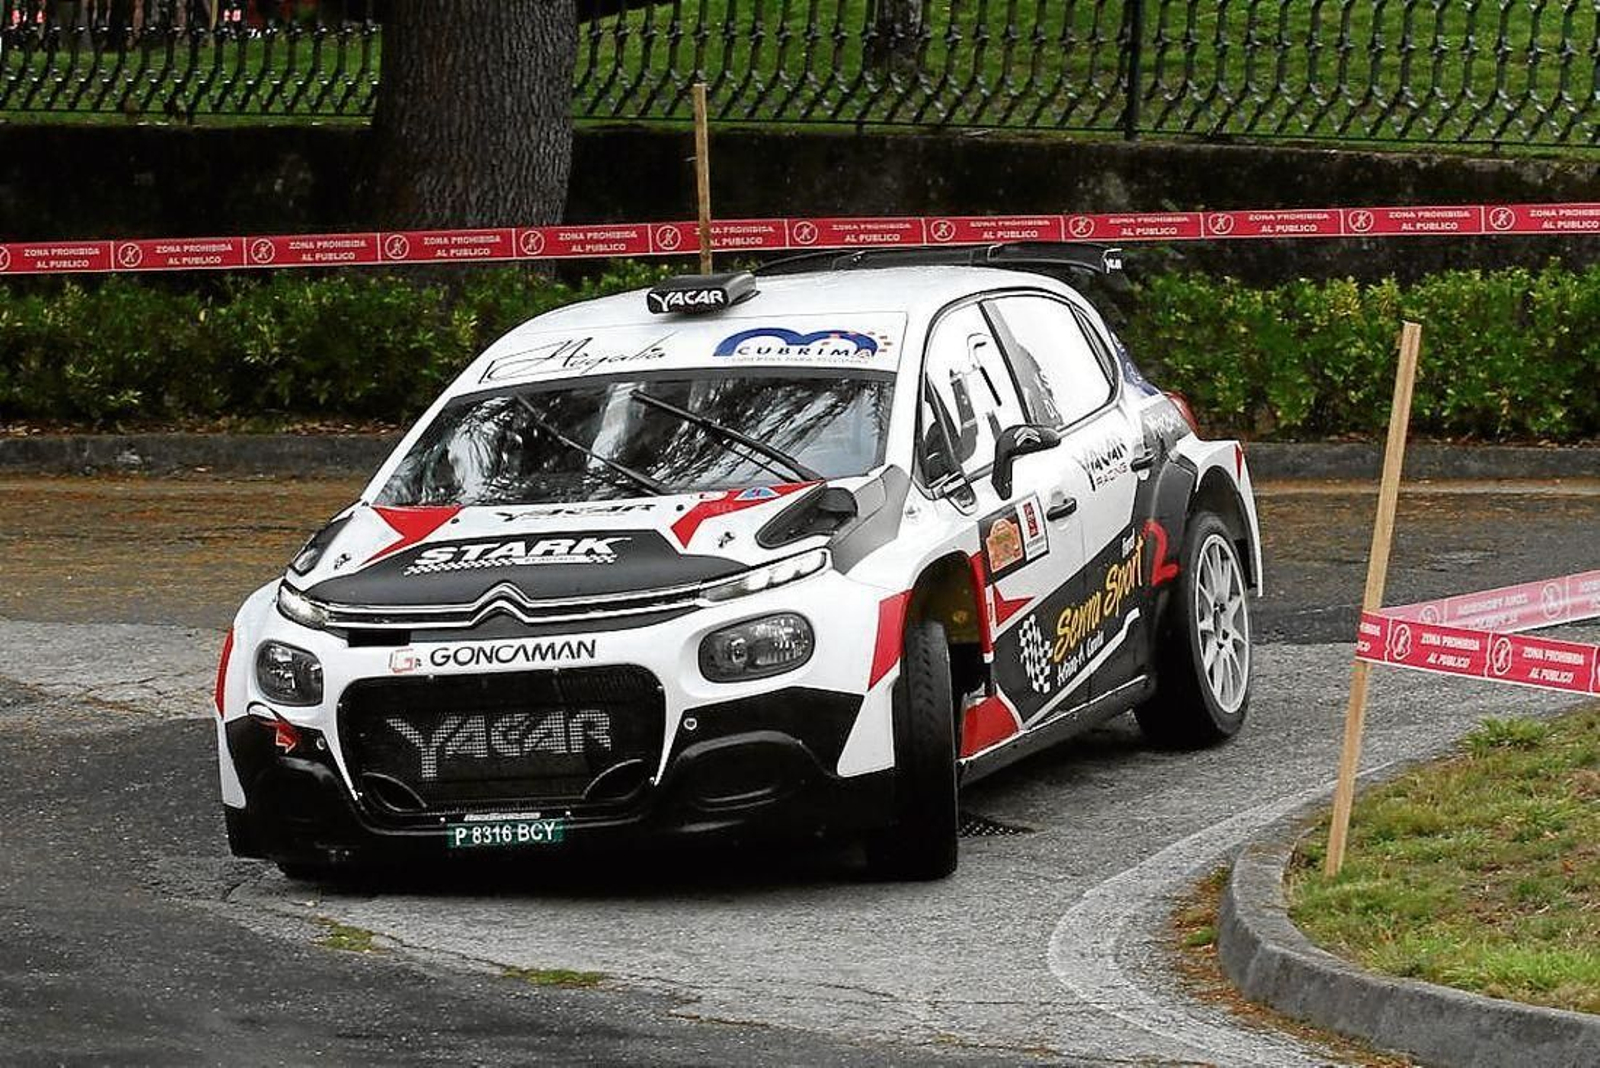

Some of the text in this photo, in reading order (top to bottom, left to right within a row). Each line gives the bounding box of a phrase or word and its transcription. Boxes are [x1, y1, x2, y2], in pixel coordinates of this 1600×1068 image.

[1248, 212, 1329, 221] ZONA PROHIBIDA
[1388, 210, 1471, 219] ZONA PROHIBIDA
[1529, 209, 1557, 218] ZONA
[969, 219, 1051, 228] ZONA PROHIBIDA
[1109, 216, 1190, 225] ZONA PROHIBIDA
[694, 226, 720, 235] ZA
[832, 222, 912, 231] ZONA PROHIBIDA
[1261, 225, 1274, 233] AL
[1401, 222, 1415, 231] AL
[559, 231, 637, 241] ZONA PROHIBIDA
[982, 230, 995, 239] AL
[1121, 228, 1135, 236] AL
[423, 235, 501, 246] ZONA PROHIBIDA
[845, 234, 858, 242] AL
[155, 243, 233, 254] ZONA PROHIBIDA
[289, 239, 368, 250] ZONA PROHIBIDA
[571, 244, 584, 252] AL
[24, 246, 100, 257] ZONA PROHIBIDA
[436, 248, 450, 257] AL
[167, 256, 180, 265] AL
[301, 253, 314, 261] AL
[36, 260, 48, 268] AL
[649, 290, 725, 312] YACAR
[415, 537, 632, 565] STARK
[1104, 535, 1144, 617] Sport
[1421, 632, 1480, 651] ZONA PROHIBIDA
[430, 639, 596, 667] GONCAMAN
[1522, 646, 1585, 665] ZONA PROHIBIDA
[1427, 652, 1437, 665] AL
[1528, 667, 1540, 679] AL
[387, 710, 611, 778] YACAR
[455, 821, 555, 846] P 8316 BCY
